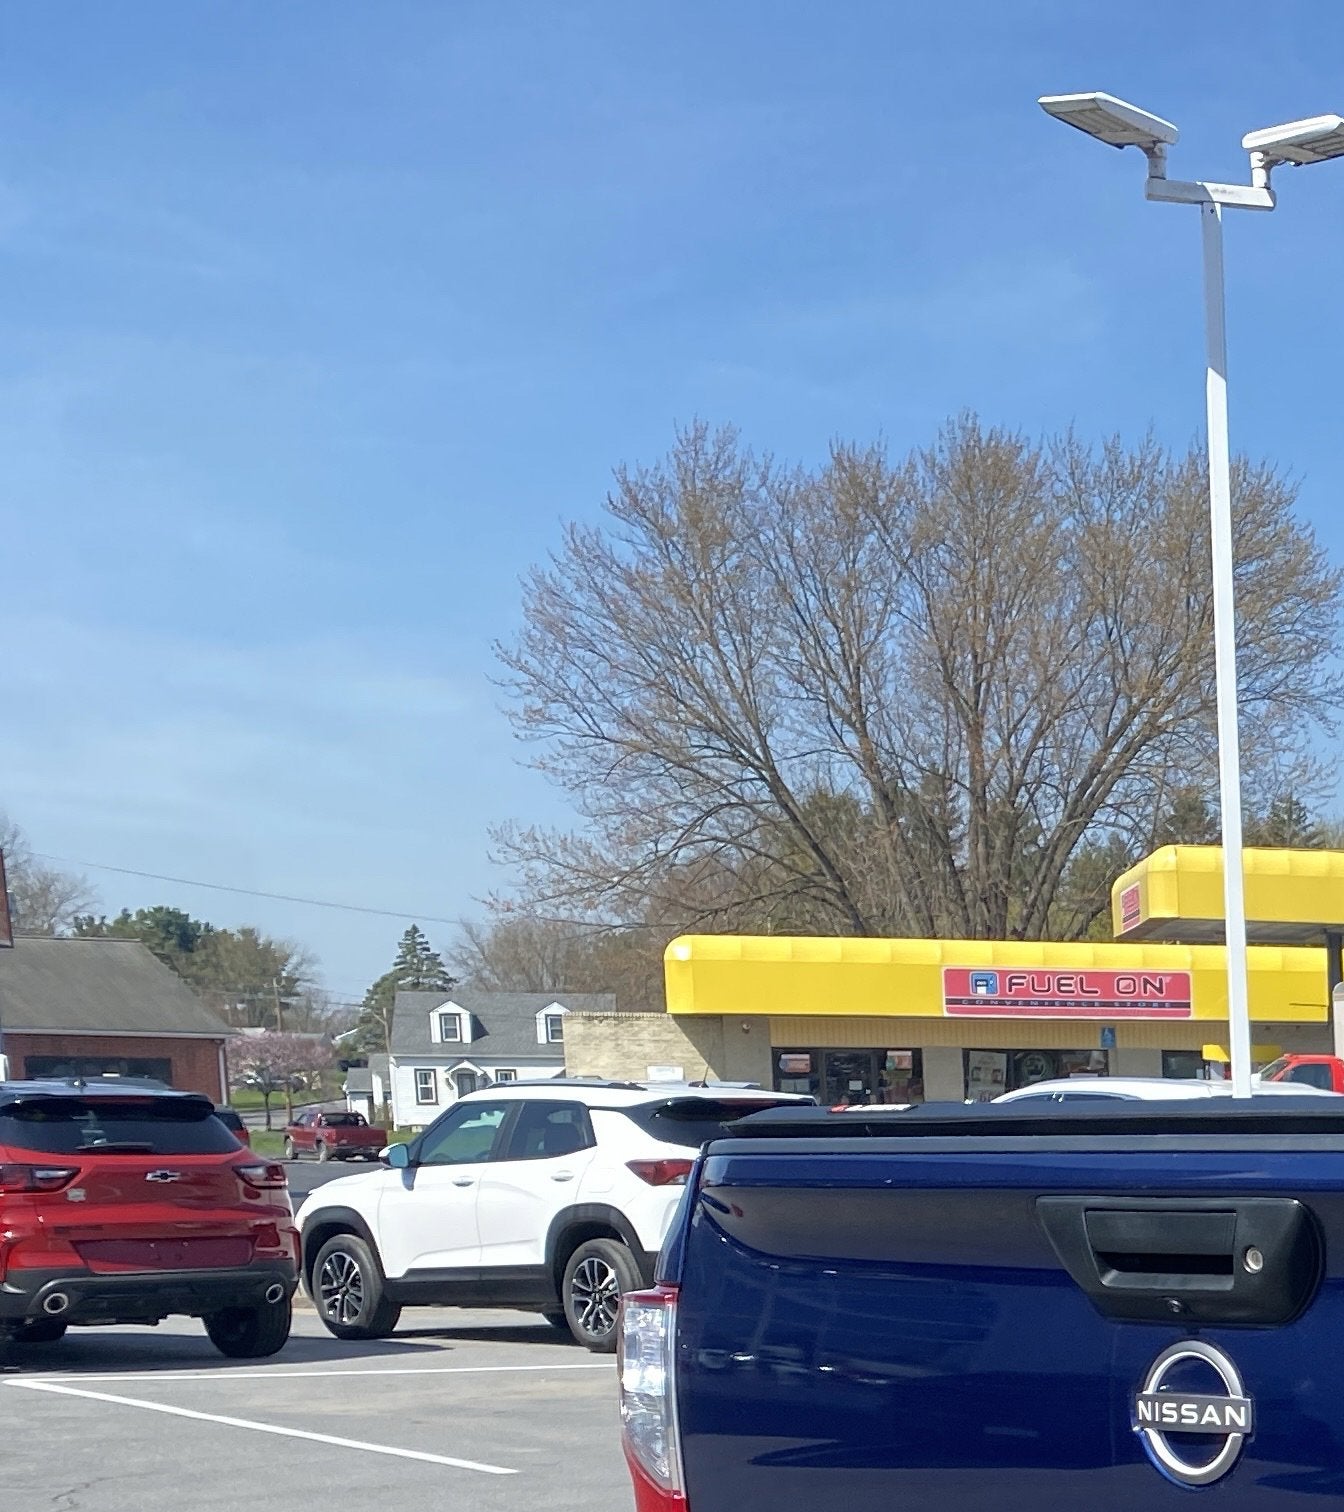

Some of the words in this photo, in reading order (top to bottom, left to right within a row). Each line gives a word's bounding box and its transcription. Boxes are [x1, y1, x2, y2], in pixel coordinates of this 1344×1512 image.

[1006, 974, 1100, 996] FUEL
[1115, 975, 1166, 997] ON
[1137, 1400, 1246, 1427] NISSAN
